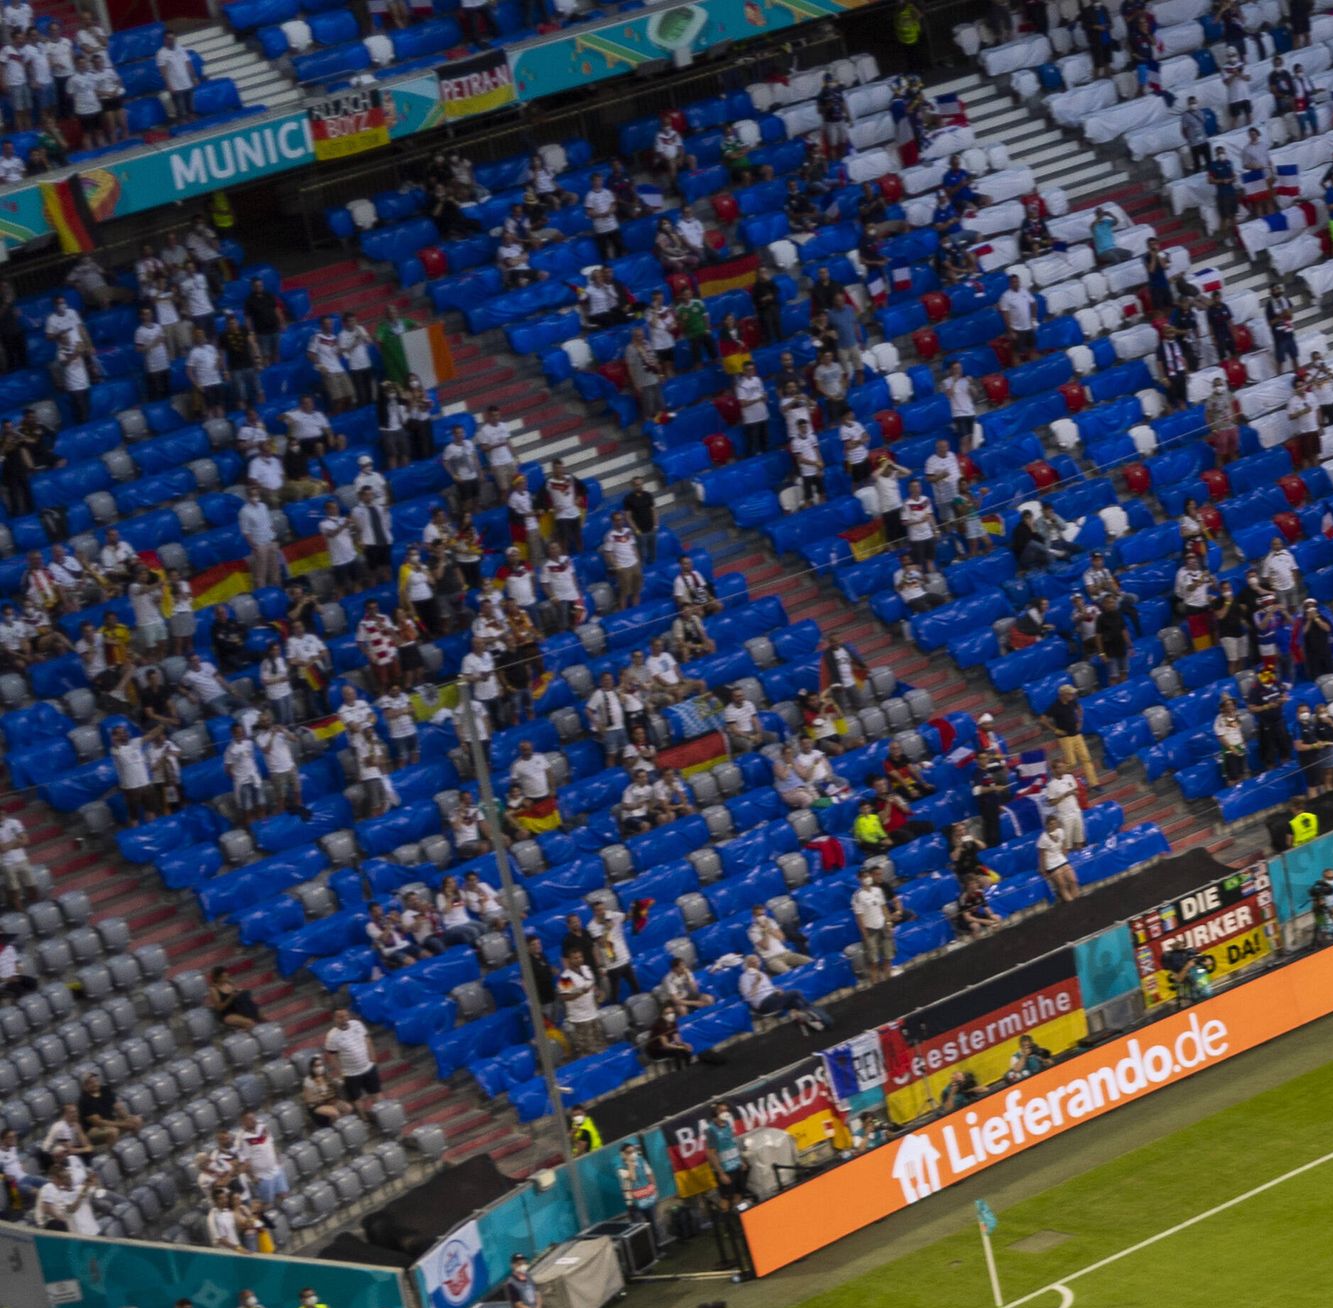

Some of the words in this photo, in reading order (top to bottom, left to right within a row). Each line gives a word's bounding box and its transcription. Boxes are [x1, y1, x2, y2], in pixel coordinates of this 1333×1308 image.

[1180, 886, 1222, 920] DIE
[1226, 932, 1261, 965] DA!
[940, 1012, 1231, 1173] Lieferando.de
